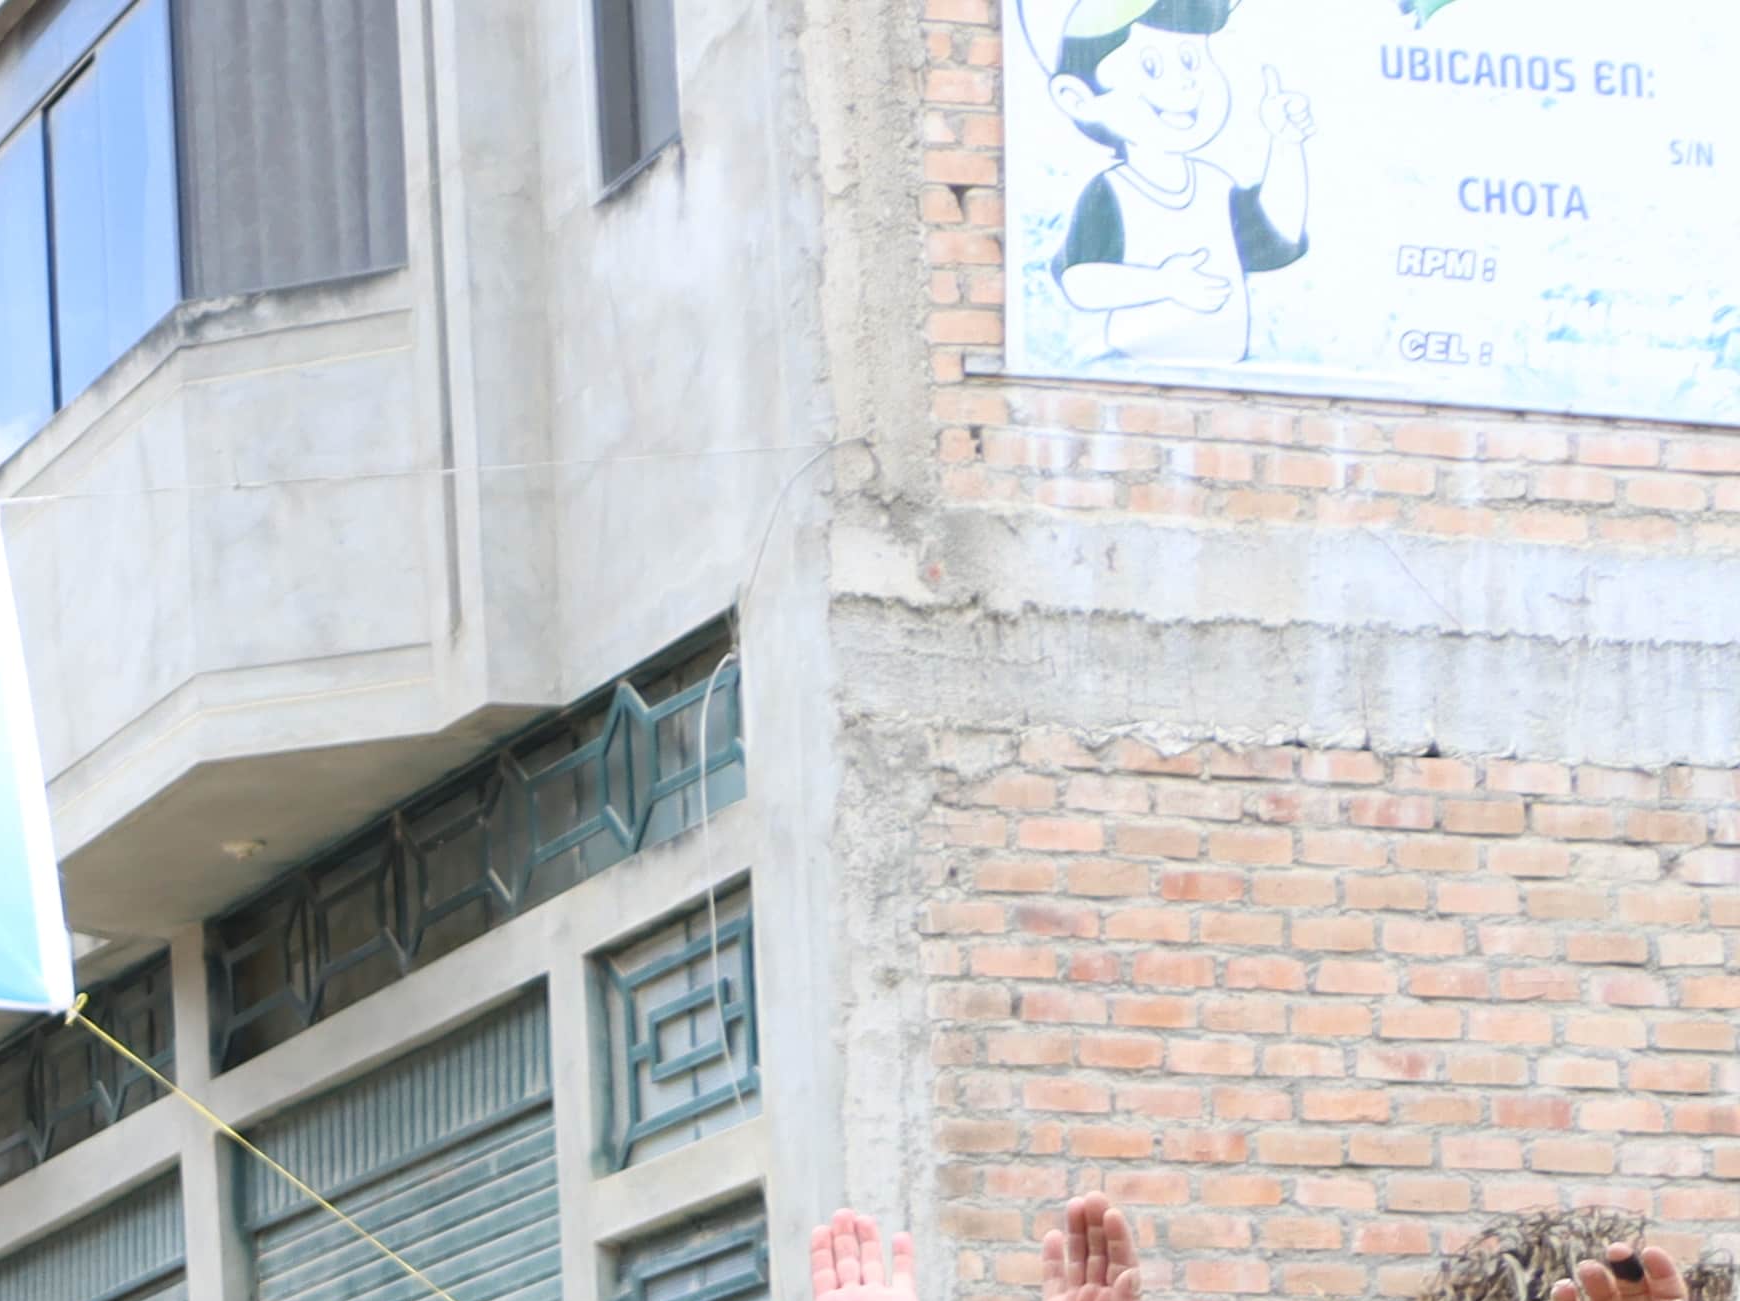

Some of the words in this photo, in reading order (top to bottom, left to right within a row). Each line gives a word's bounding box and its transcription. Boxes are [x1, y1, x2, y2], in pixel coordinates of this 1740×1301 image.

[1380, 44, 1576, 93] UBICANOS
[1593, 60, 1656, 99] EN:
[1668, 139, 1715, 168] S/N
[1457, 176, 1590, 221] CHOTA
[1396, 245, 1476, 282] RPM
[1399, 330, 1469, 364] CEL
